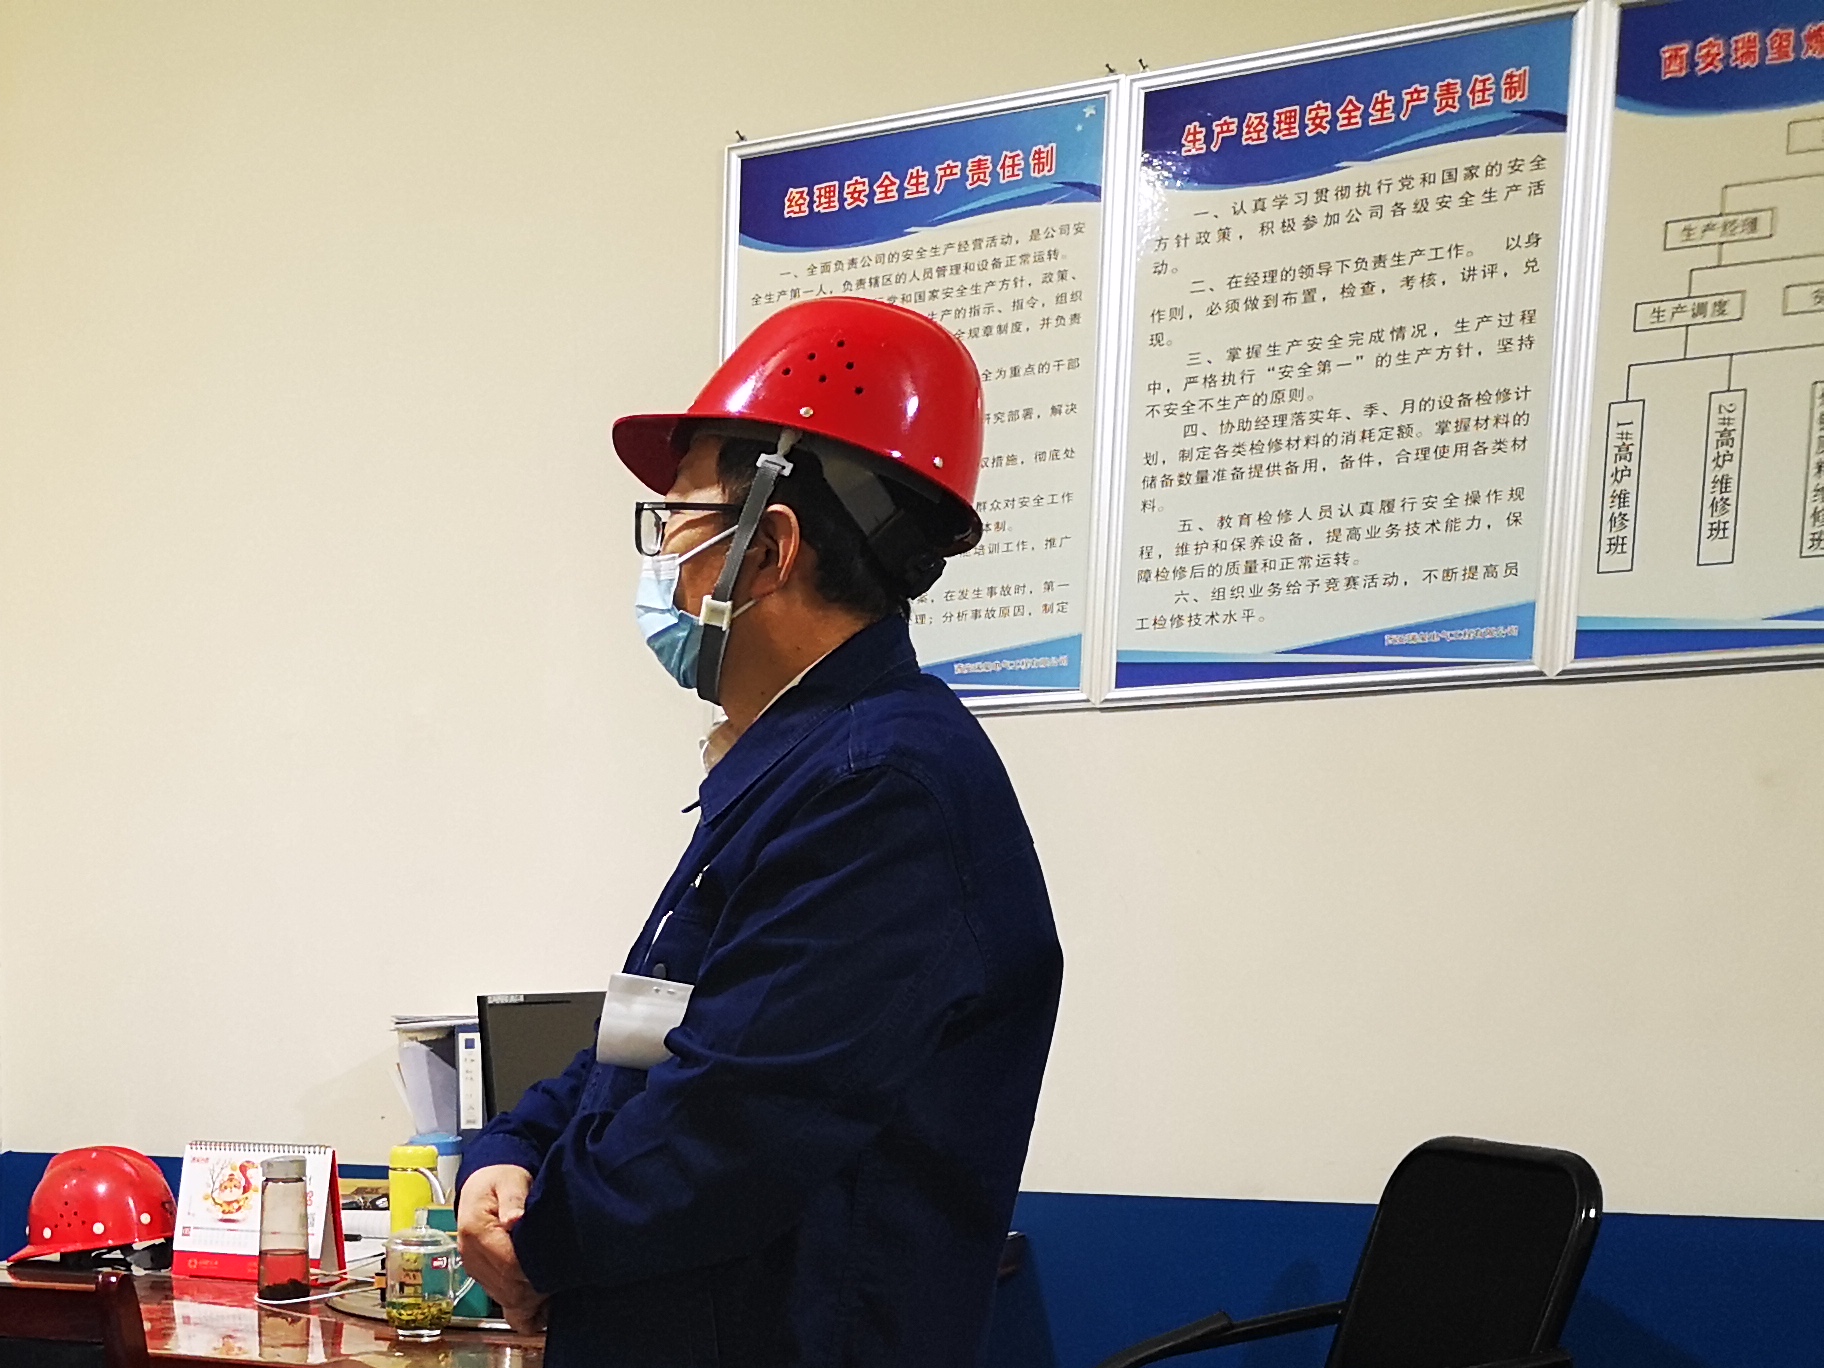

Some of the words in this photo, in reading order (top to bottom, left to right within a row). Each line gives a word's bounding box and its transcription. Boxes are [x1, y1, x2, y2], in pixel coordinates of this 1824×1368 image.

[1180, 66, 1530, 157] 生产经理安全生产责任制
[783, 143, 1059, 218] 经理安全生产责任制
[1681, 216, 1759, 242] 生产经理
[875, 268, 1078, 305] 党和国家安全生产方针，政策、
[1649, 299, 1730, 324] 生产调度
[1606, 420, 1634, 555] 1#高炉维修班
[1707, 401, 1737, 541] 2#高炉维修班
[959, 536, 1072, 557] 培训工作，推广
[910, 601, 1069, 625] 理；分析事故原因，制定
